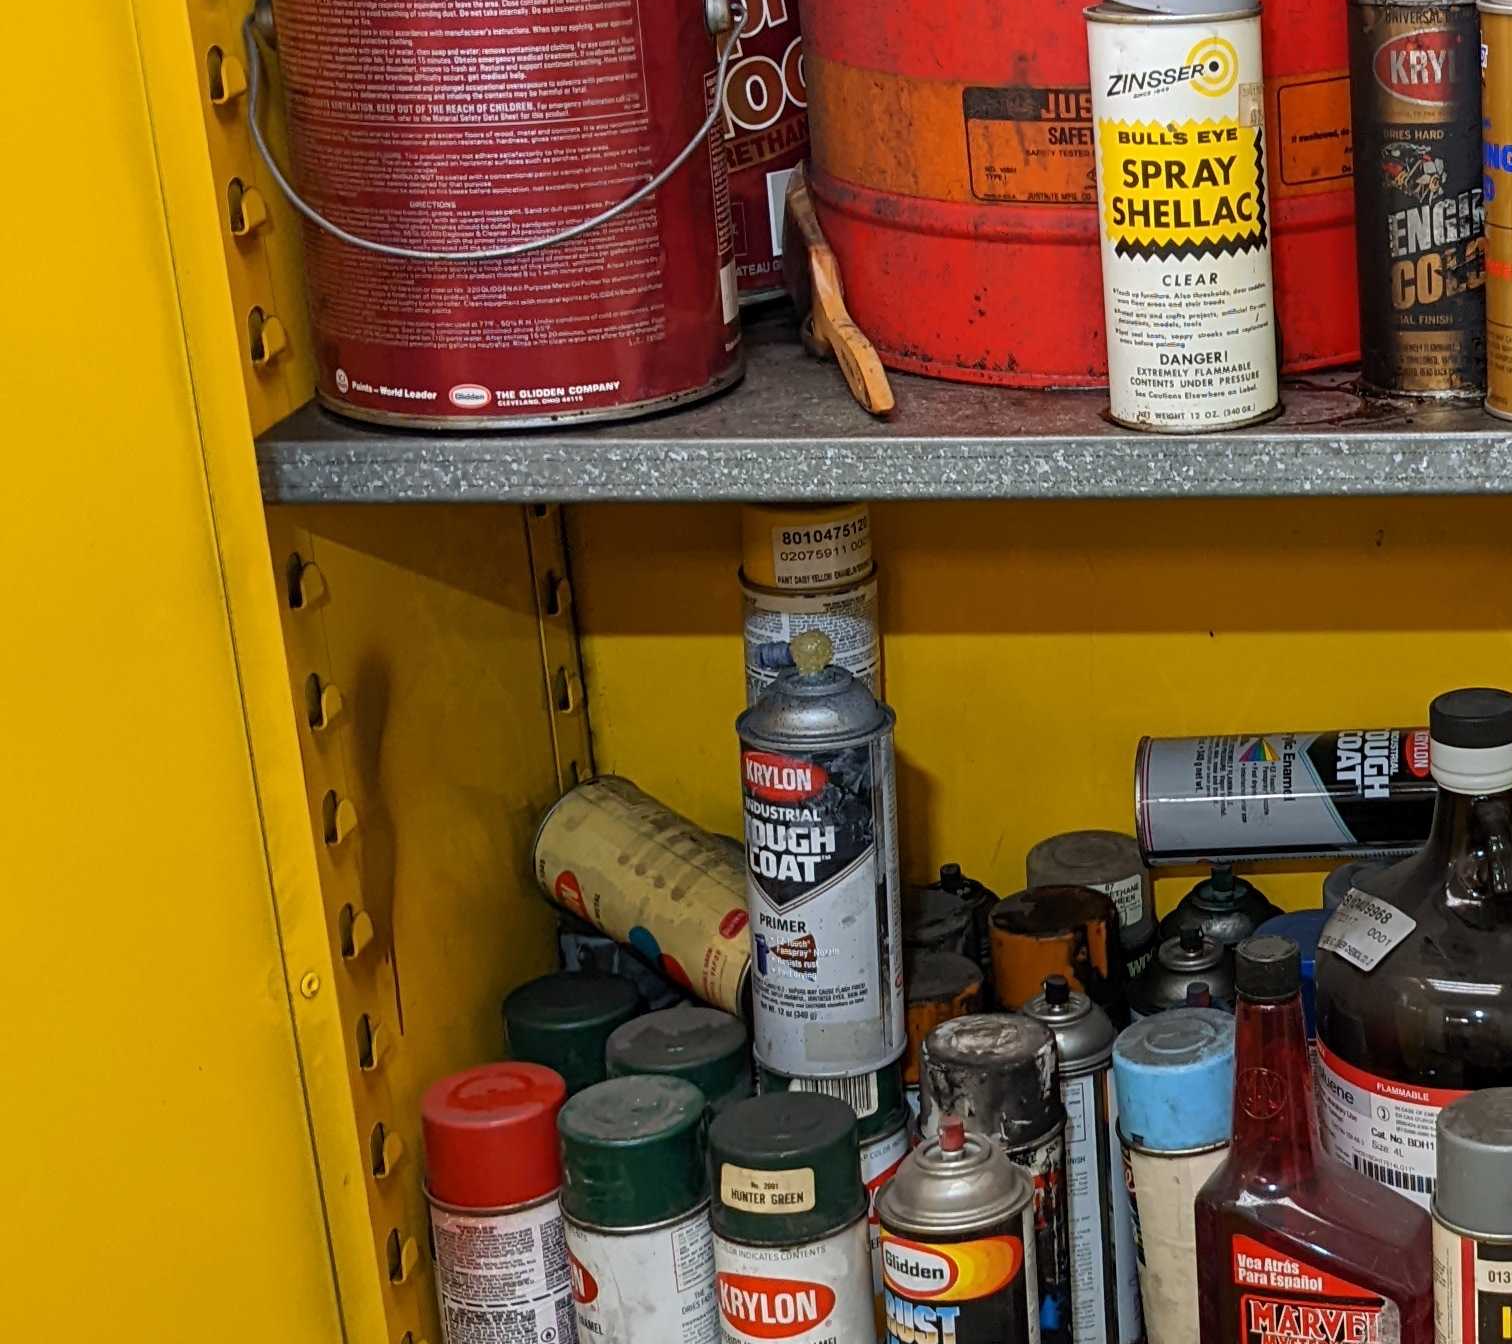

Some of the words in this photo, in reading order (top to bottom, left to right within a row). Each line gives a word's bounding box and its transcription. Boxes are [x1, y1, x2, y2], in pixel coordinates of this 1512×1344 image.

[1106, 63, 1205, 97] ZINSSER
[1198, 128, 1238, 143] EYE
[1122, 155, 1237, 189] SPRAY
[1112, 191, 1252, 228] SHELLAC
[1162, 272, 1218, 287] CLEAR
[1160, 351, 1228, 365] DANGER!
[1130, 377, 1175, 388] CONTENTS
[1180, 377, 1214, 388] UNDER
[1219, 371, 1259, 385] PRESSURE
[1137, 367, 1188, 377] EXTREMELY
[1195, 361, 1251, 376] FLAMMABLE
[495, 390, 516, 400] THE
[519, 386, 565, 399] GLIDDEN
[568, 380, 620, 394] COMPANY
[745, 759, 812, 792] KRYLON
[750, 845, 822, 883] COAT
[759, 912, 806, 933] PRIMER
[1376, 1082, 1430, 1101] FLAMMABLE
[731, 1189, 766, 1205] HUNTER
[771, 1191, 804, 1205] GREEN
[885, 1248, 946, 1280] Glidden
[1237, 1254, 1263, 1271] Vea
[1238, 1268, 1268, 1284] Para
[1270, 1271, 1322, 1292] Español
[719, 1279, 818, 1324] KRYLON
[1249, 1299, 1382, 1344] MARVEL
